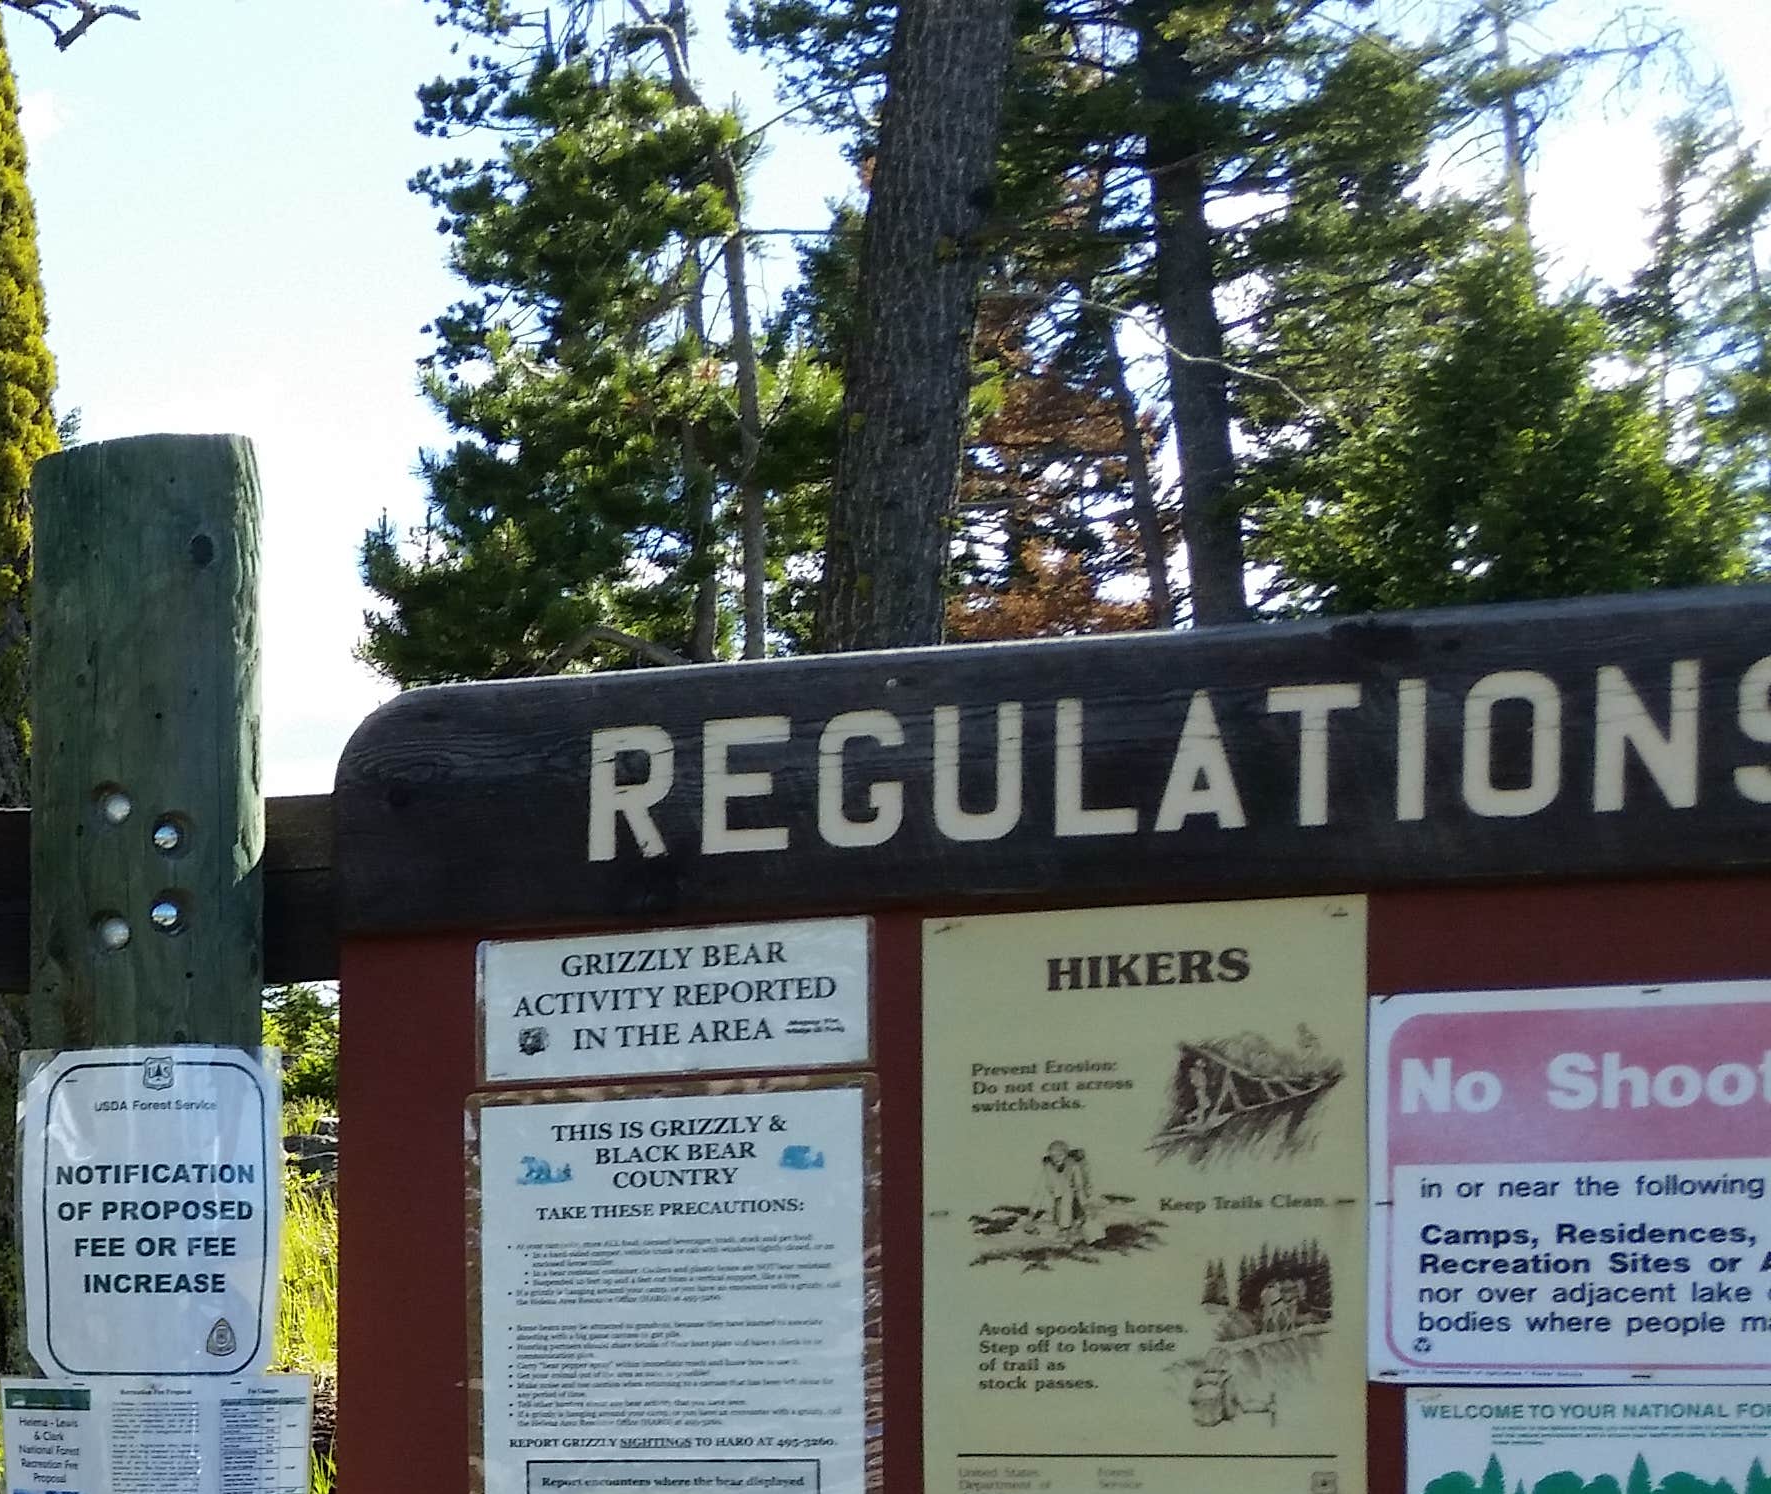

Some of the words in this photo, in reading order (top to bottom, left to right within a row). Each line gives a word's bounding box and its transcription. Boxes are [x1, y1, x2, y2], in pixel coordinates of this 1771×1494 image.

[562, 947, 693, 976] GRIZZLY
[702, 942, 787, 967] BEAR
[1047, 948, 1250, 991] HIKERS
[513, 986, 664, 1017] ACTIVITY
[674, 977, 836, 1007] REPORTED
[574, 1027, 607, 1050] IN
[615, 1023, 679, 1047] THE
[688, 1018, 774, 1043] AREA
[1400, 1058, 1502, 1115] No
[1546, 1050, 1771, 1110] Shoo
[551, 1123, 612, 1141] THIS
[620, 1122, 643, 1138] IS
[650, 1116, 763, 1137] GRIZZLY
[769, 1115, 787, 1132] &
[596, 1145, 680, 1164] BLACK
[687, 1142, 756, 1160] BEAR
[57, 1164, 253, 1184] NOTIFICATION
[613, 1168, 738, 1188] COUNTRY
[1421, 1178, 1442, 1198] in
[1457, 1183, 1484, 1198] or
[1499, 1181, 1559, 1197] near
[1575, 1176, 1619, 1196] the
[1636, 1174, 1765, 1199] following
[58, 1202, 92, 1221] OF
[103, 1201, 252, 1220] PROPOSED
[75, 1238, 125, 1256] FEE
[136, 1237, 176, 1256] OR
[188, 1237, 236, 1256] FEE
[1421, 1224, 1538, 1249] Camps,
[1556, 1223, 1755, 1247] Residences,
[1420, 1253, 1590, 1274] Recreation
[1609, 1252, 1690, 1273] Sites
[1709, 1258, 1742, 1272] or
[85, 1274, 225, 1293] INCREASE
